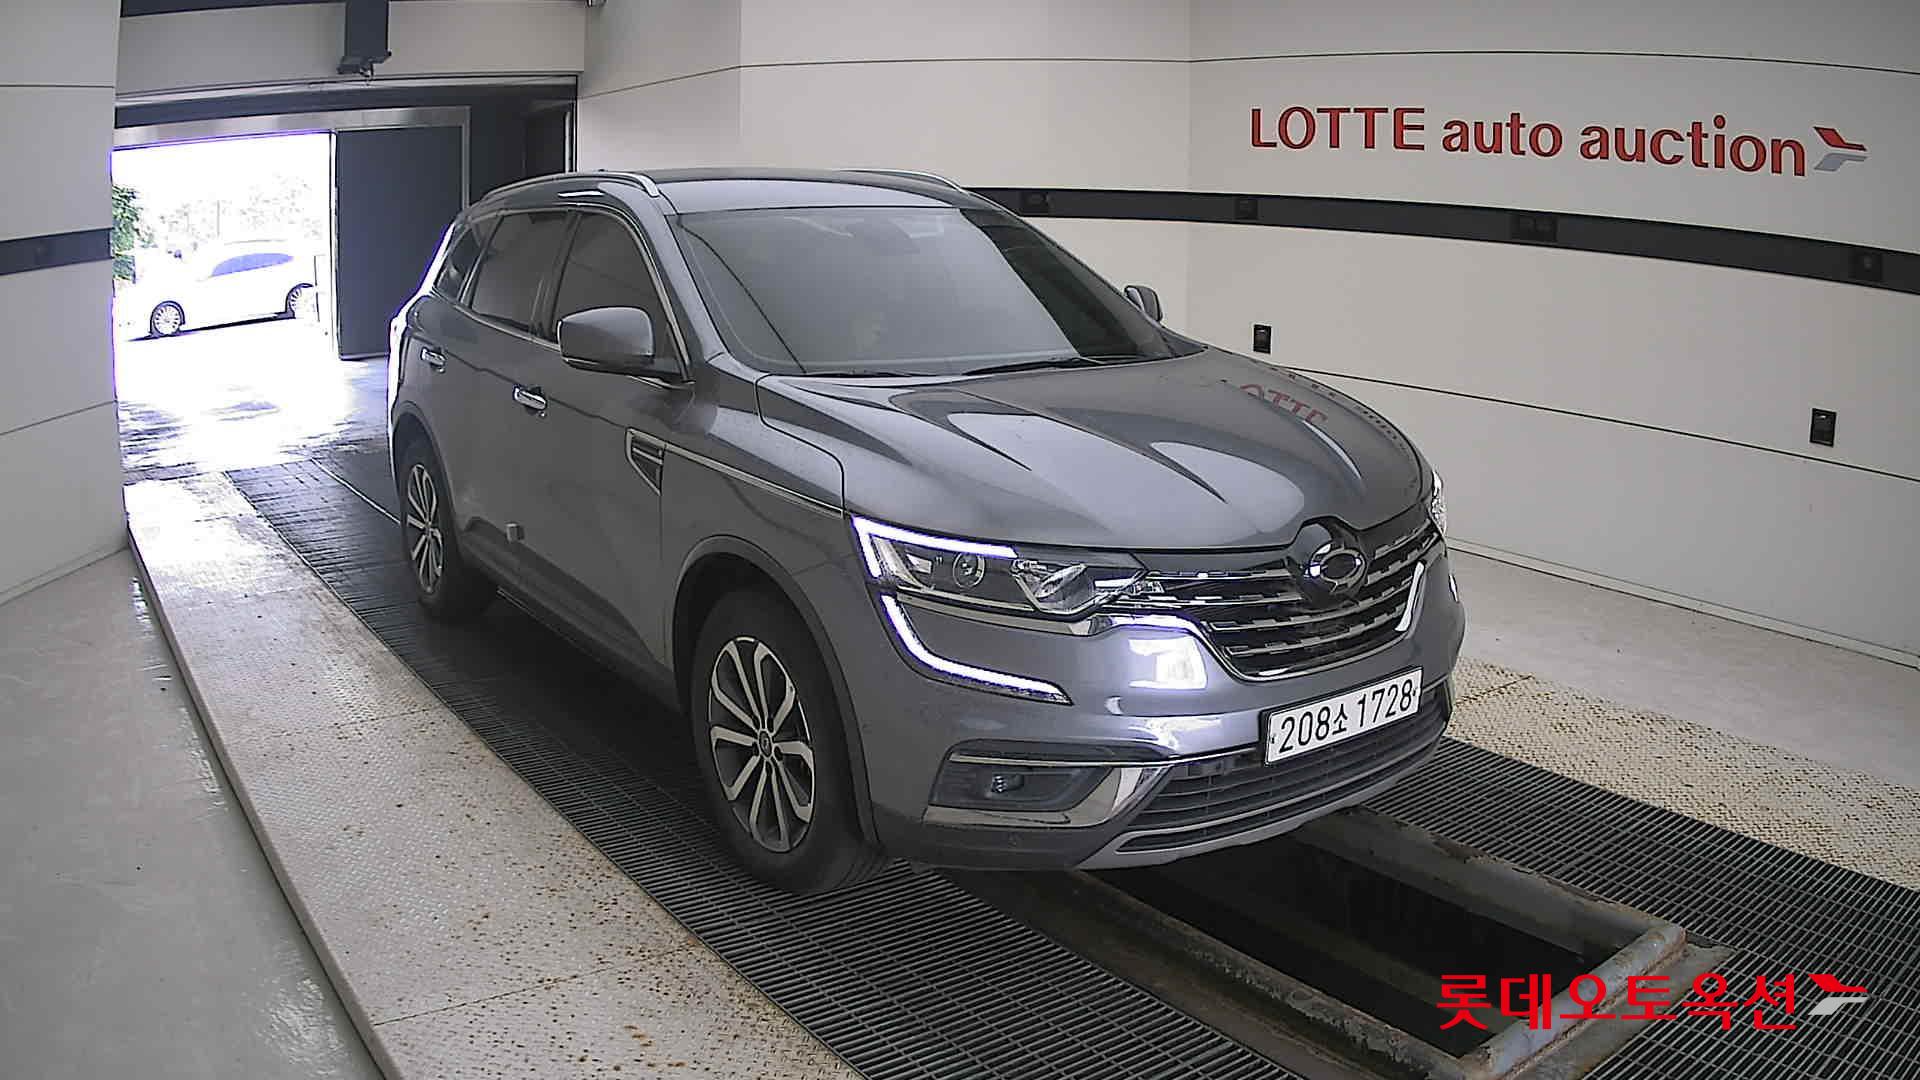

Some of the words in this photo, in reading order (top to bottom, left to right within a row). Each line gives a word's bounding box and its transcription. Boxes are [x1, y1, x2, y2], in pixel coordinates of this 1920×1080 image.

[1251, 107, 1425, 151] LOTTE
[1442, 112, 1563, 158] auto
[1580, 114, 1807, 177] auction
[1278, 703, 1348, 754] 208소
[1357, 678, 1413, 728] 1728
